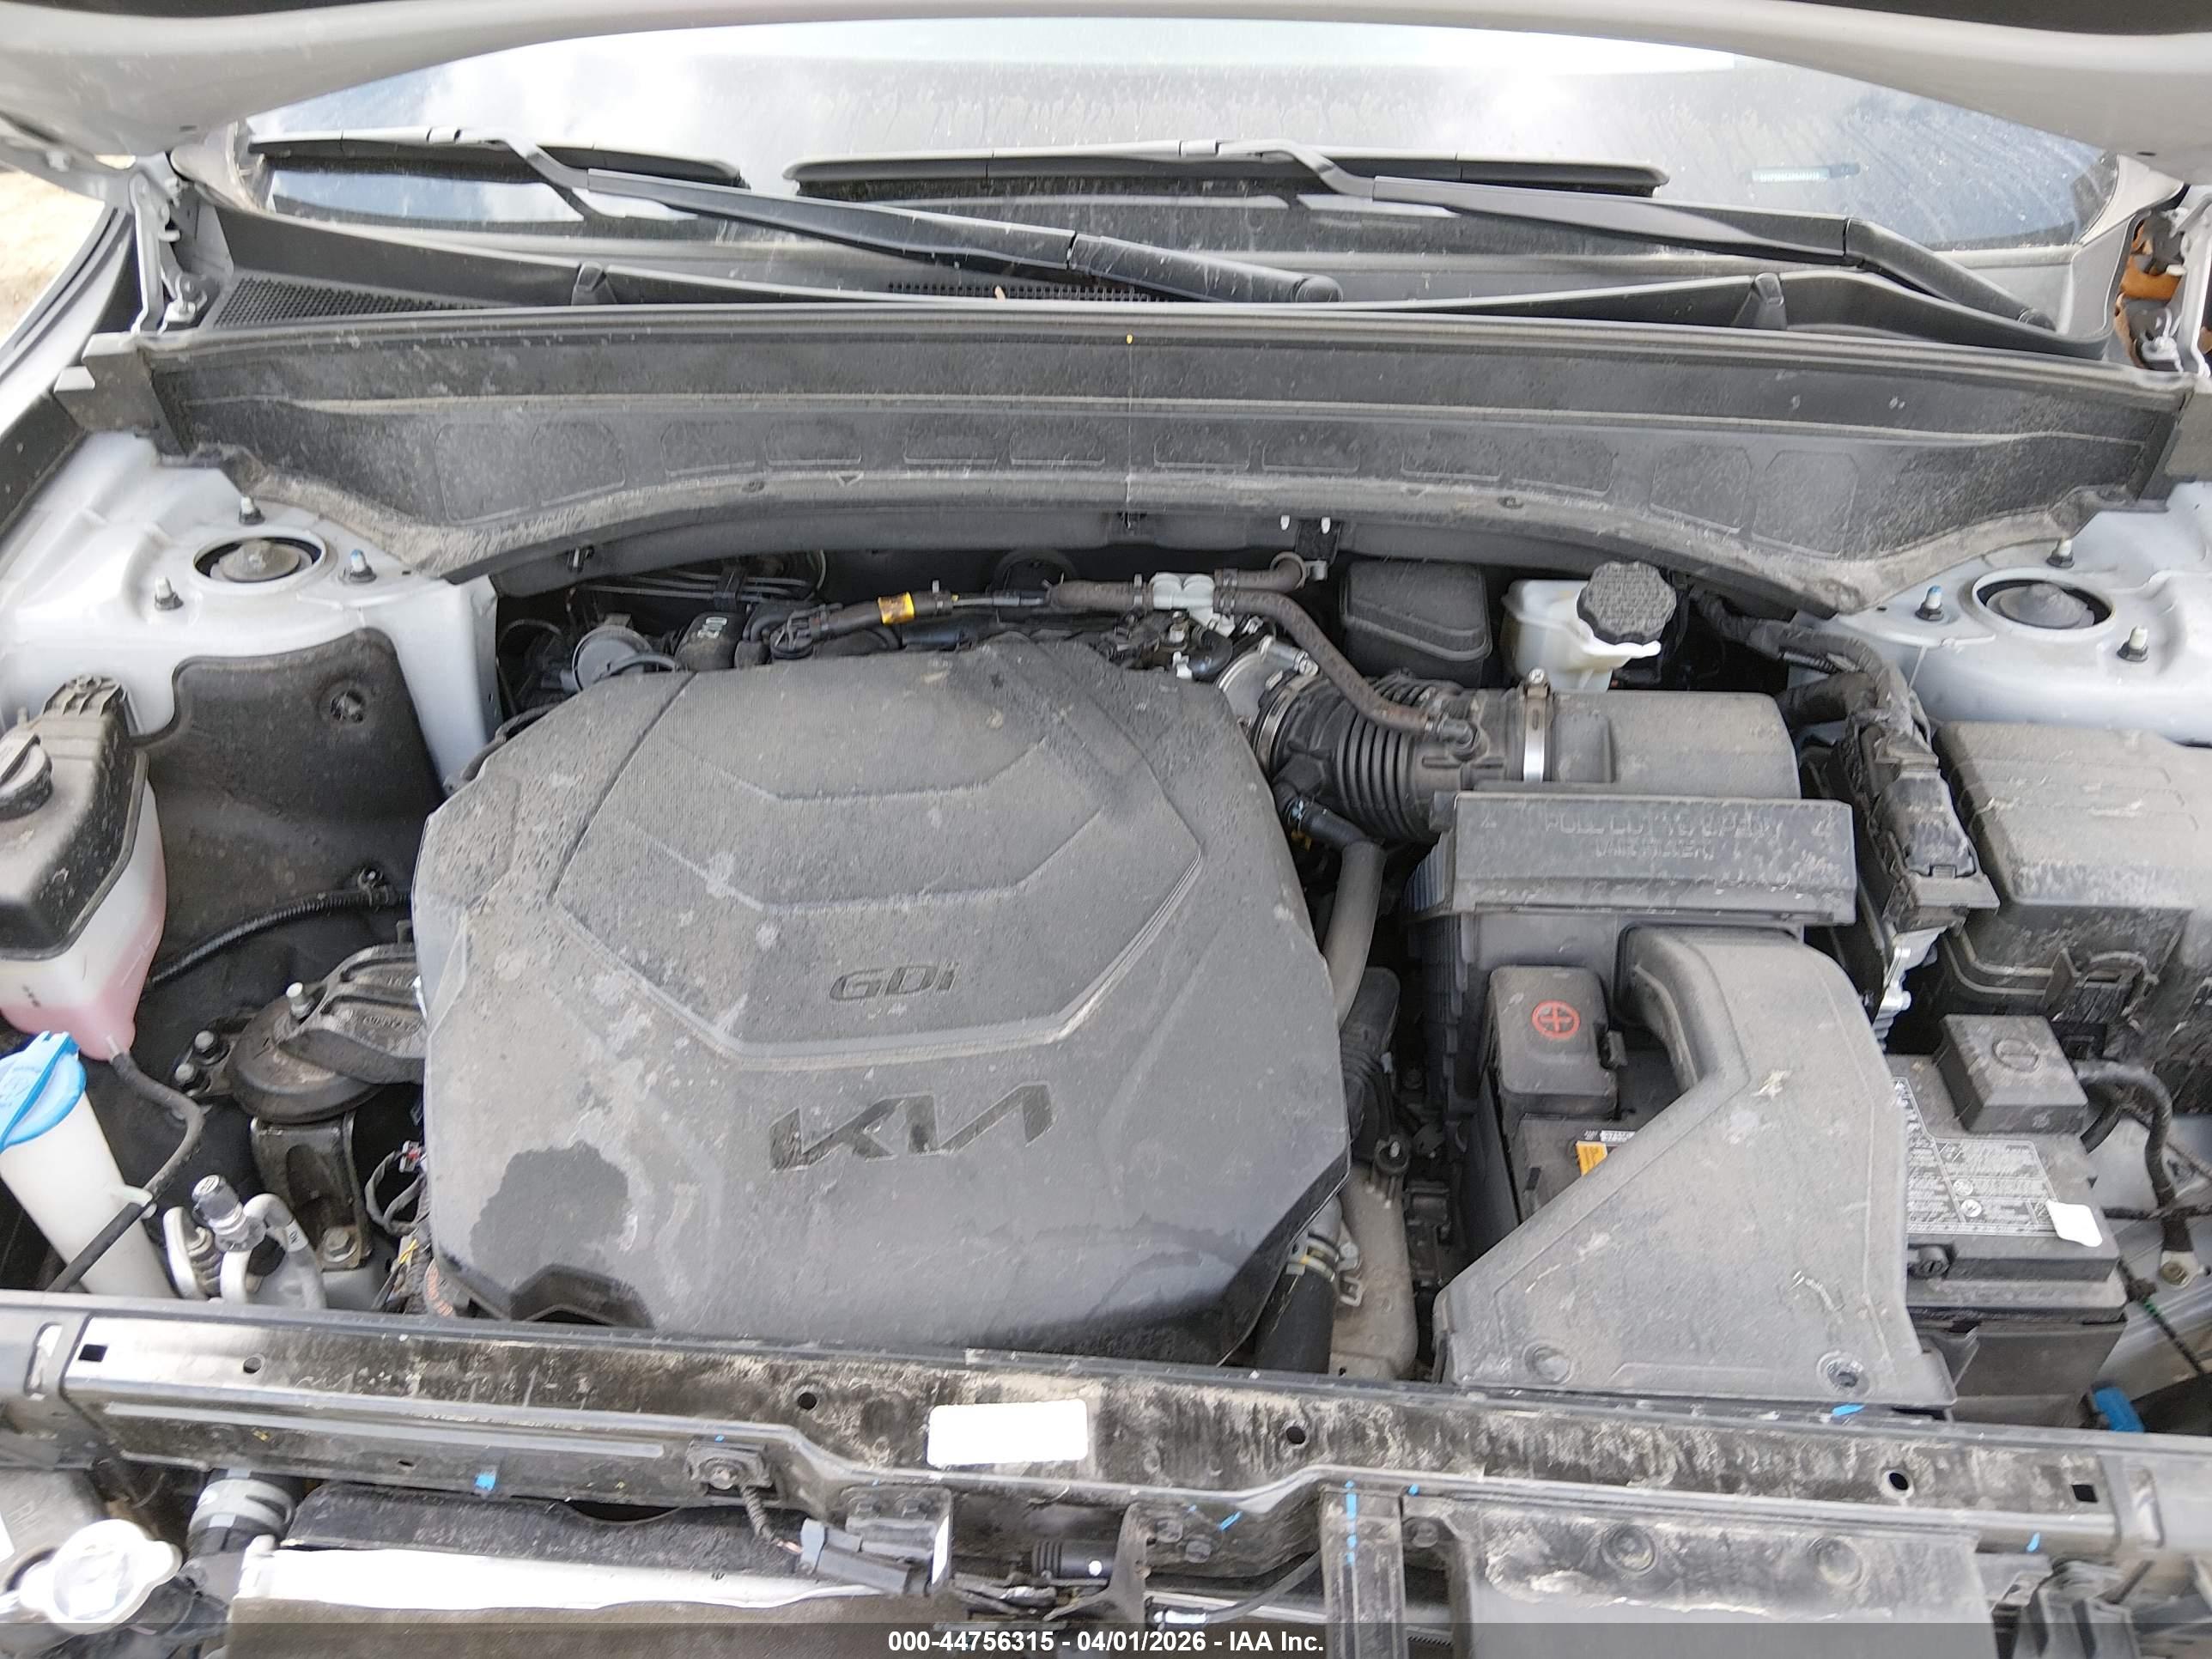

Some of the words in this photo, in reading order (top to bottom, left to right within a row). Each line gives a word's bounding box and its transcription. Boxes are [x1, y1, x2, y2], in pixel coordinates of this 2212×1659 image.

[1545, 812, 1604, 834] PULL
[1610, 812, 1658, 835] OUT
[1662, 813, 1696, 836] TO
[769, 1080, 1057, 1173] KIA
